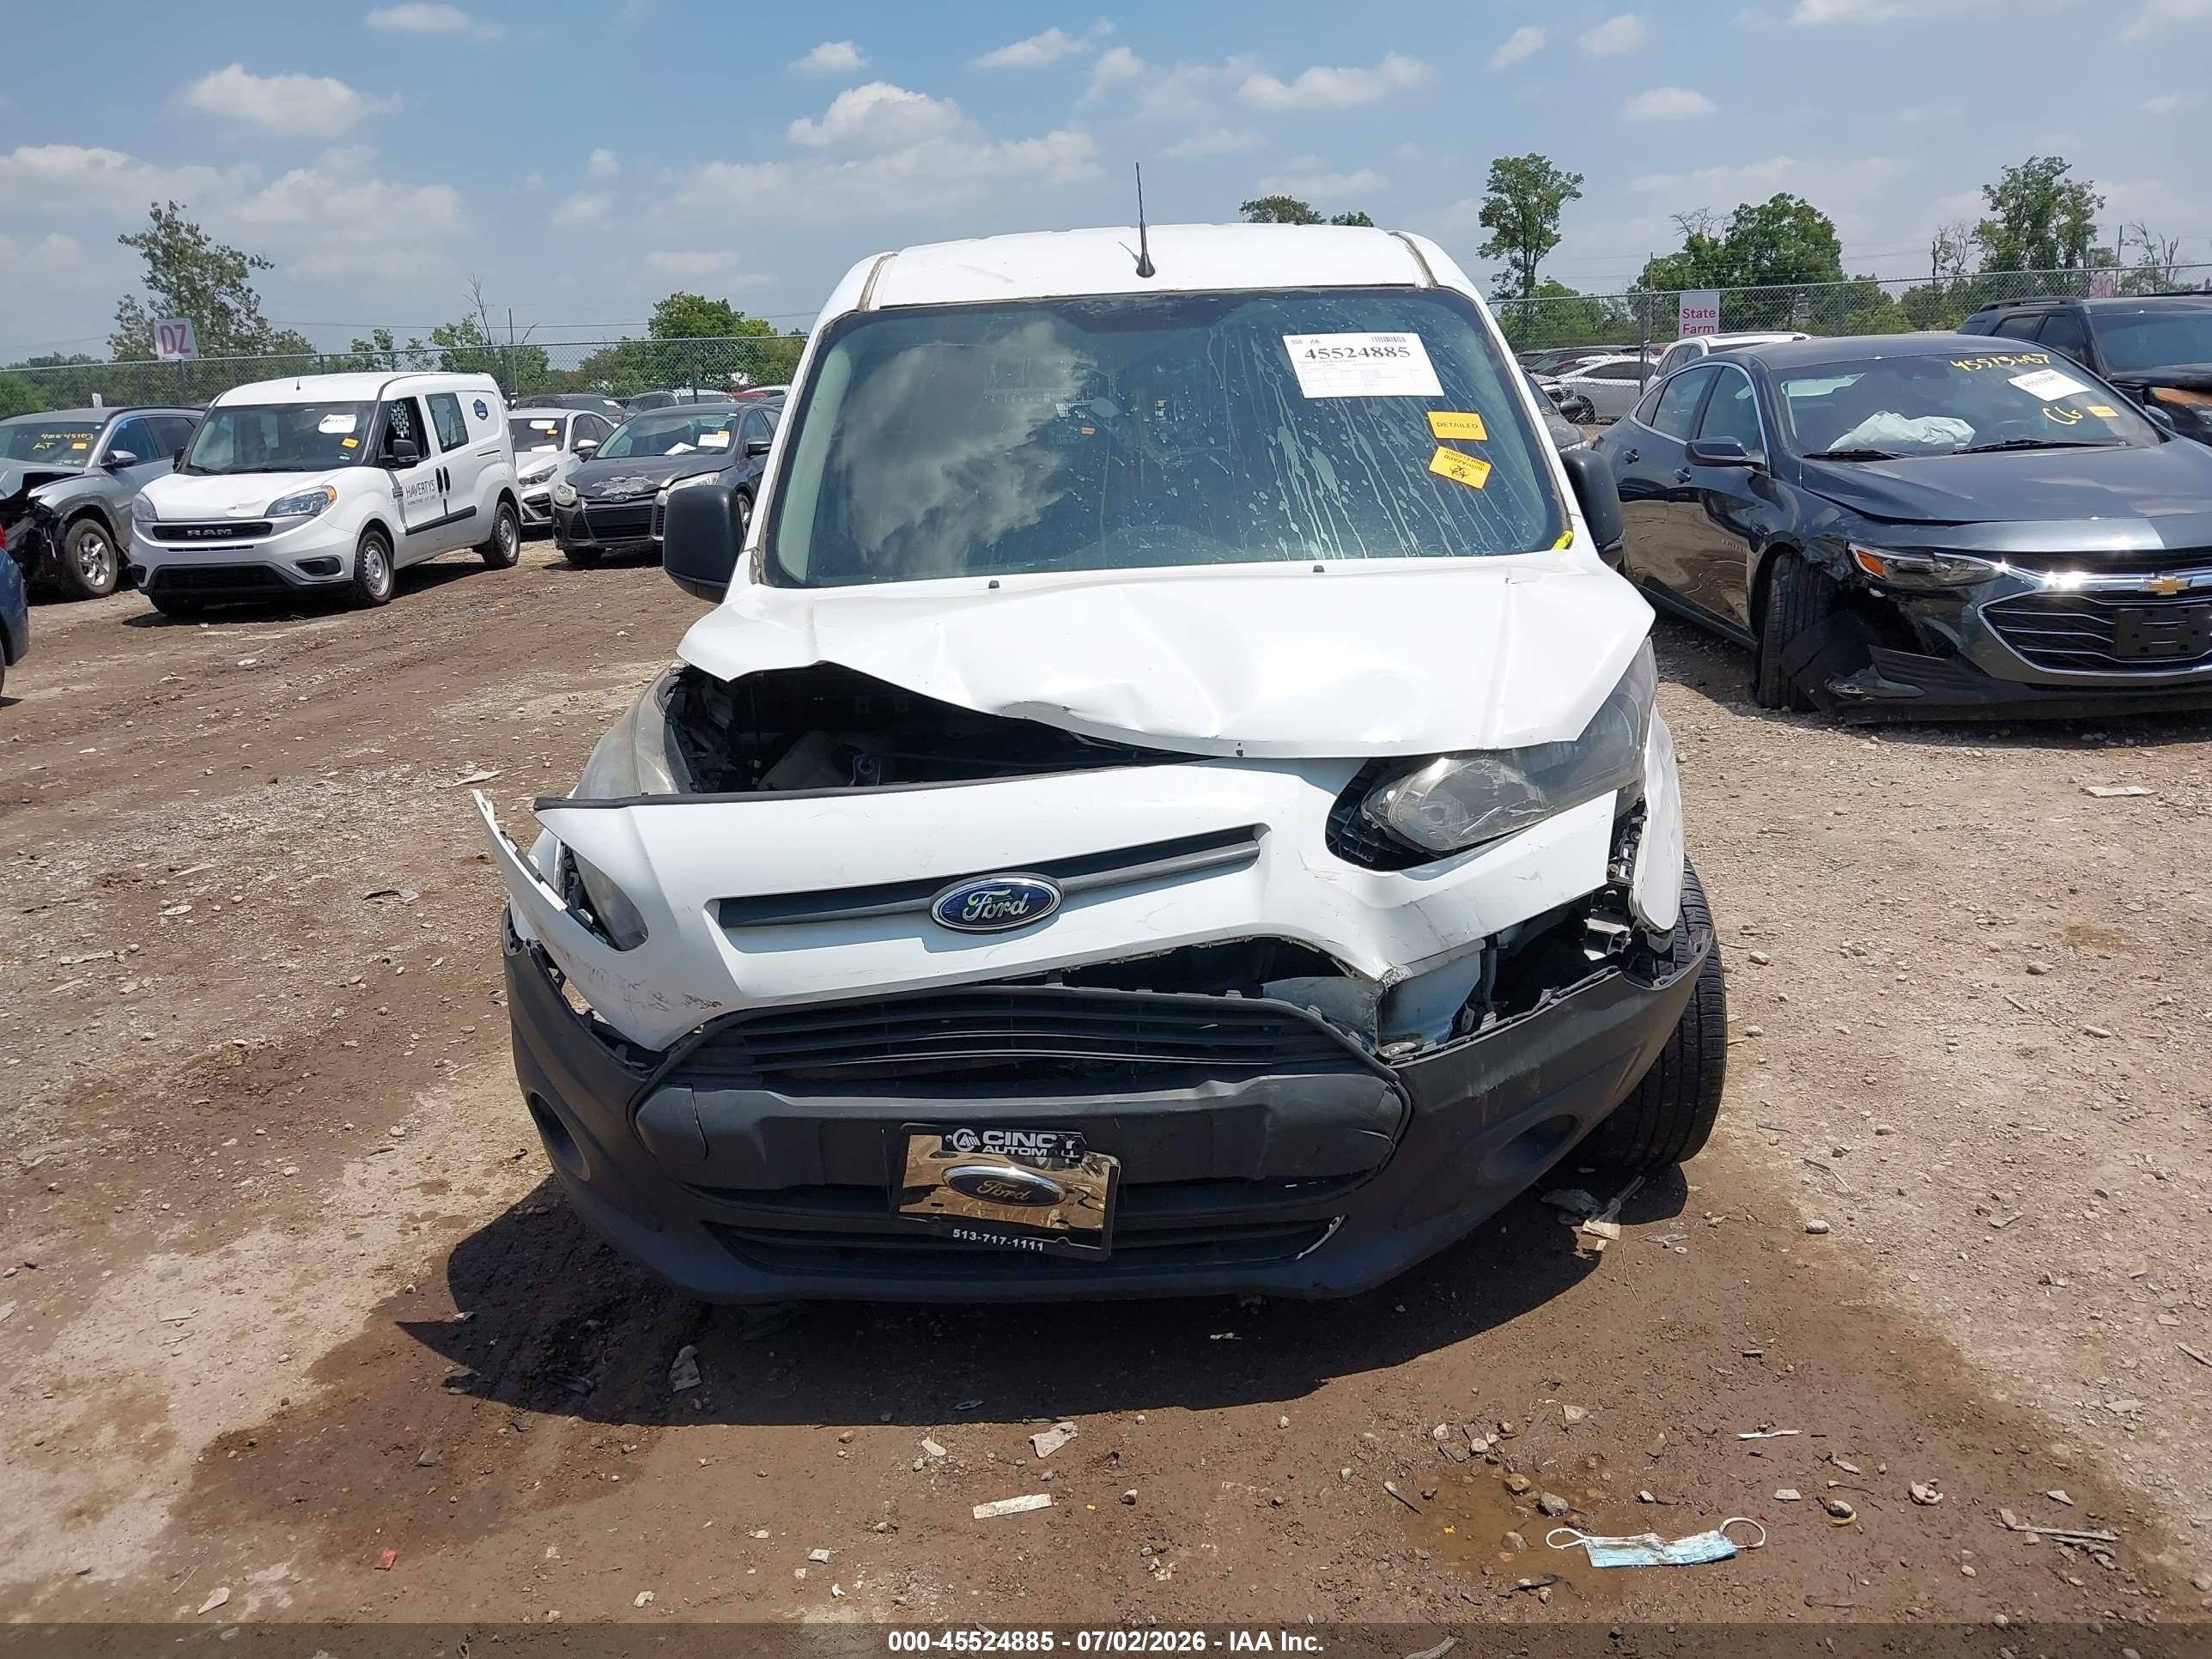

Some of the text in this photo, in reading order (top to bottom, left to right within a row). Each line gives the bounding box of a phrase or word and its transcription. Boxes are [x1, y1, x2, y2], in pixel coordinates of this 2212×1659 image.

[1682, 307, 1717, 319] State
[1683, 323, 1715, 334] Farm
[160, 324, 191, 355] DZ
[1304, 346, 1411, 360] 45524885
[1436, 421, 1479, 429] DETAILED
[1443, 454, 1483, 471] BIOHAZARD
[404, 479, 435, 499] HAVERTYS
[186, 528, 233, 537] RAM
[962, 888, 1030, 921] Ford
[976, 1180, 1031, 1201] Ford
[952, 1228, 1044, 1252] 513-717-1111
